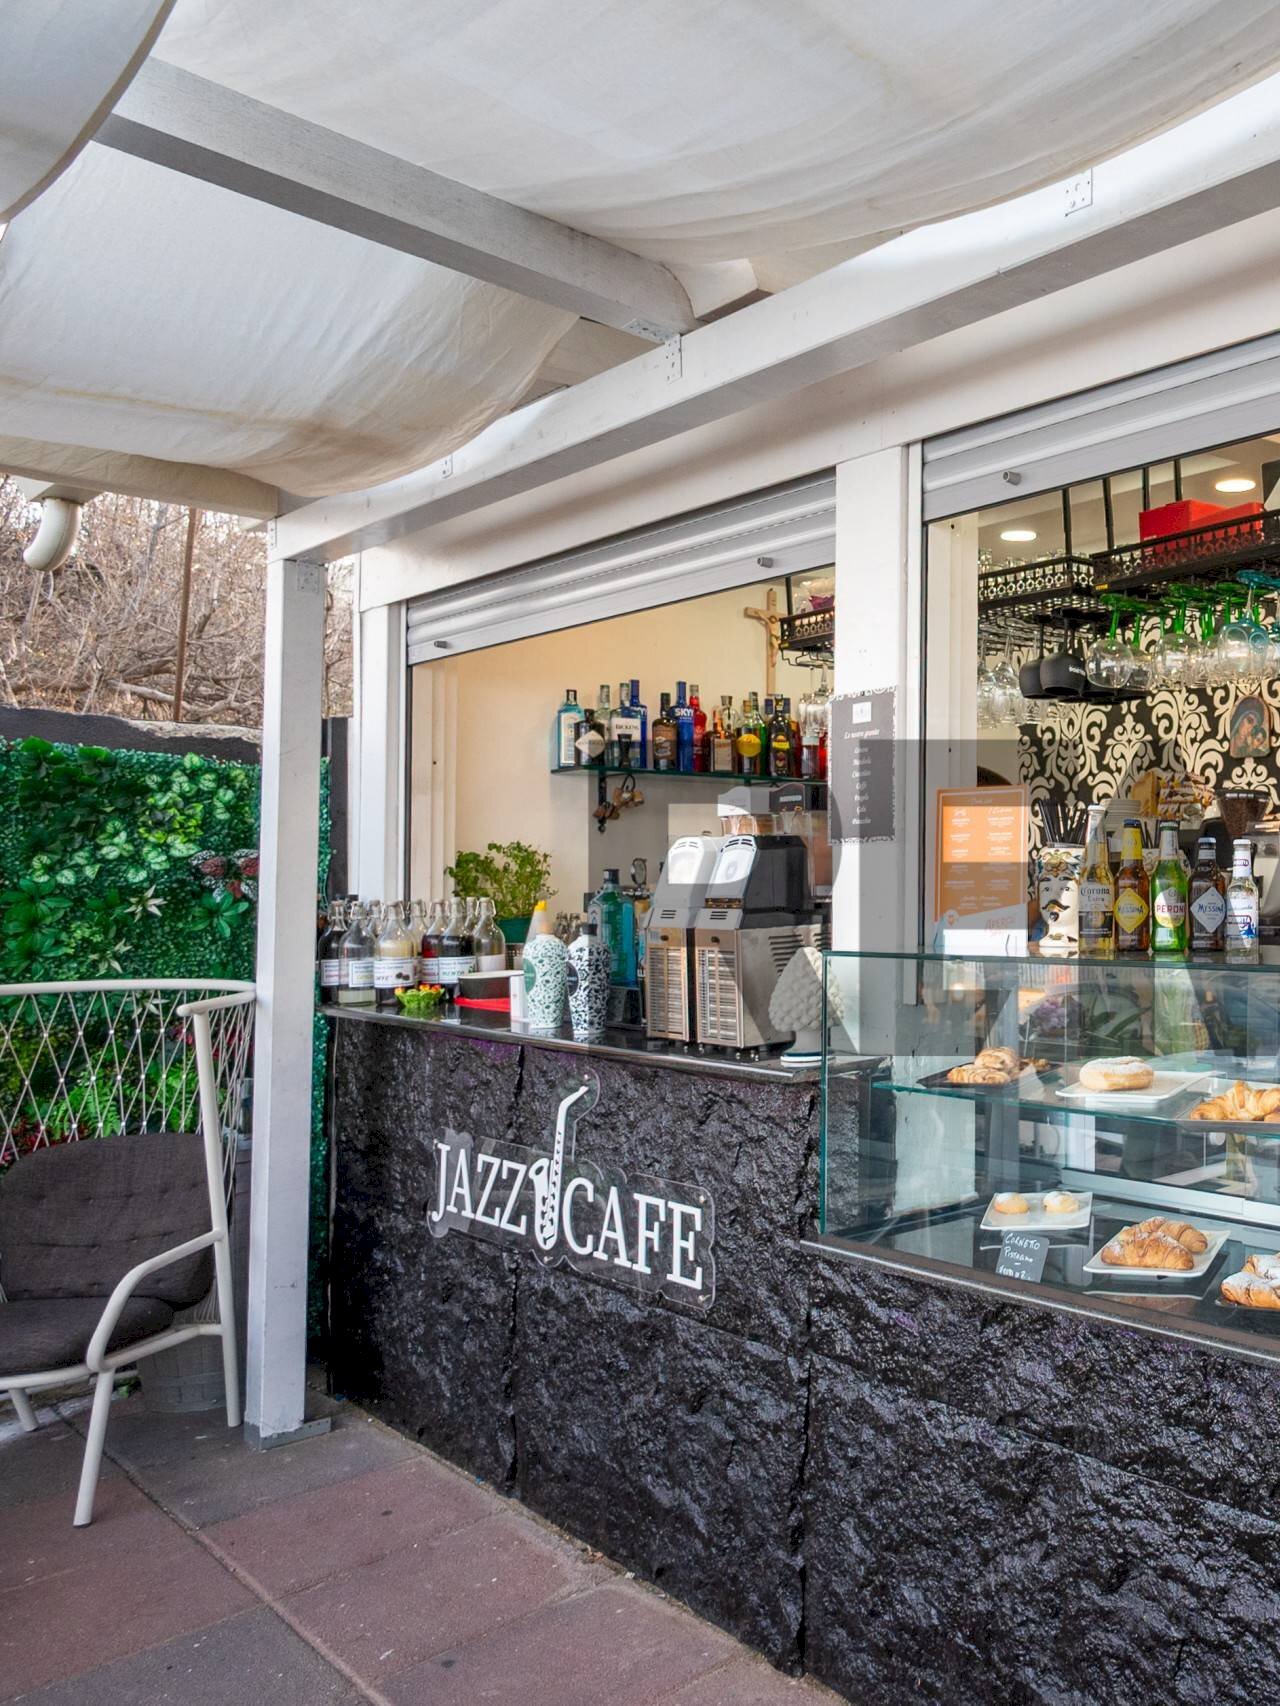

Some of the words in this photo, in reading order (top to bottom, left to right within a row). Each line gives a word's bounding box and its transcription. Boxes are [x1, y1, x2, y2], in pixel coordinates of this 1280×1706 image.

[1156, 904, 1187, 913] PERON
[431, 1141, 527, 1235] JAZZ
[562, 1177, 702, 1290] CAFE
